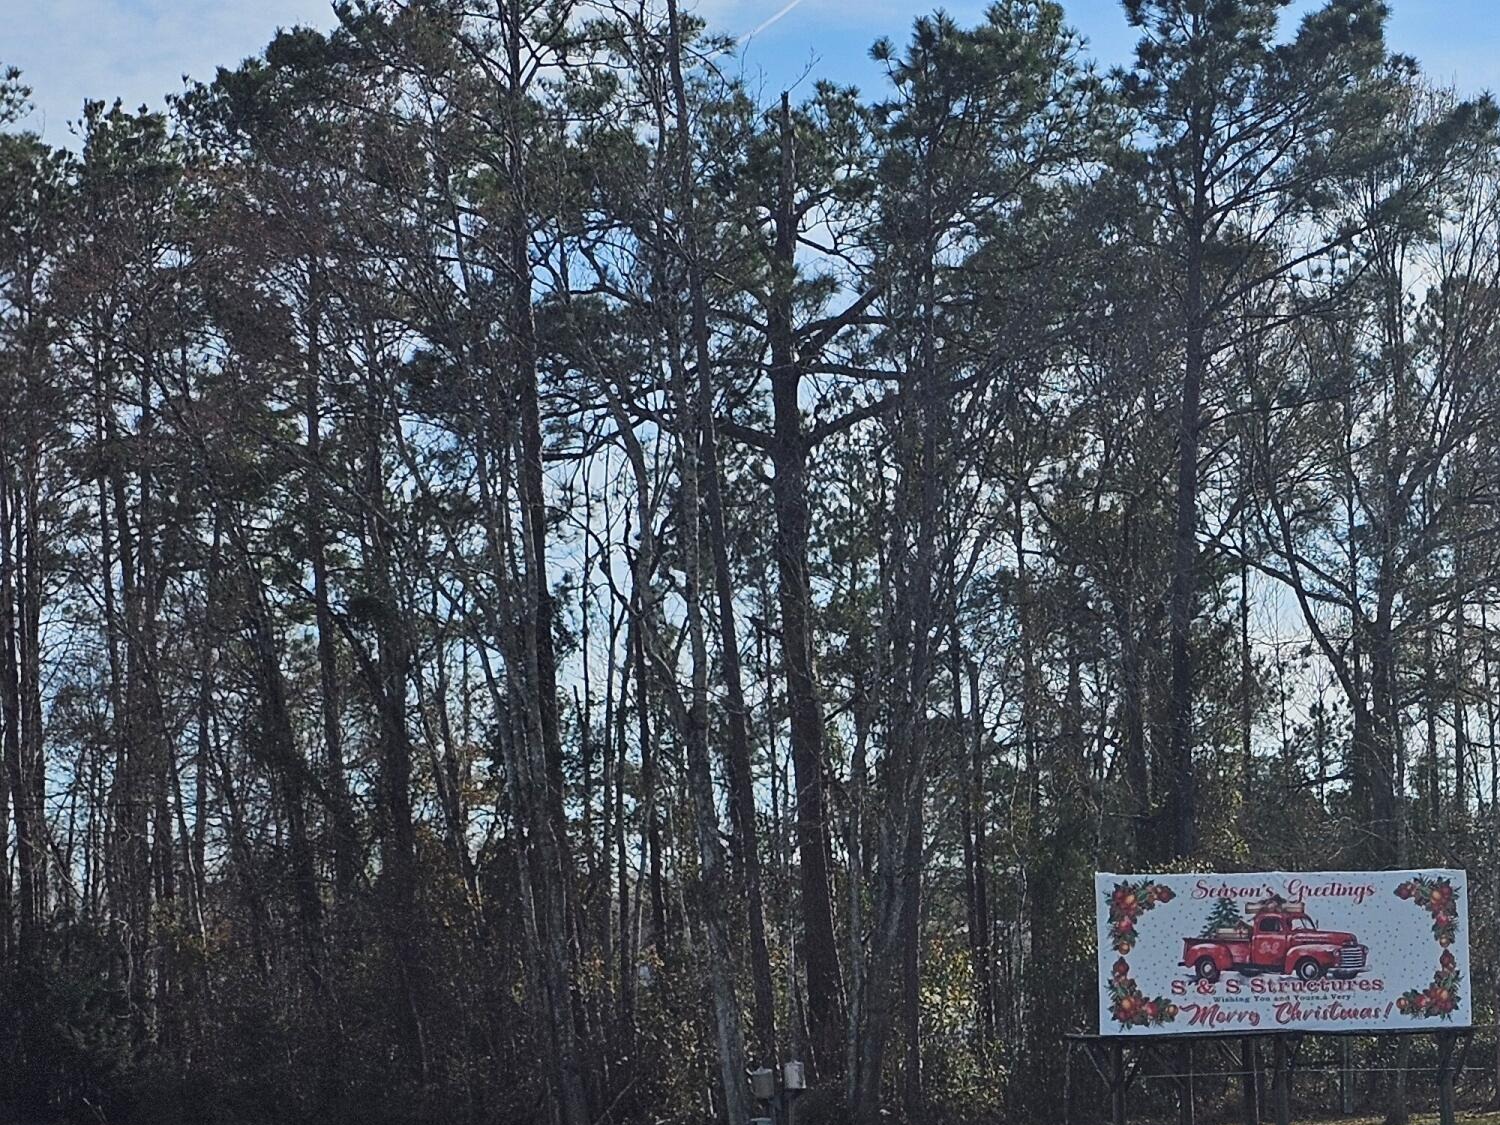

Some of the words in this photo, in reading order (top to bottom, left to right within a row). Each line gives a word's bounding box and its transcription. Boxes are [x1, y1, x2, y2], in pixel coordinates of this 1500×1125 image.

[1191, 879, 1275, 900] Season's
[1283, 878, 1376, 904] Greetings
[1170, 979, 1188, 995] S
[1195, 978, 1217, 995] &
[1225, 978, 1242, 994] S
[1250, 977, 1385, 995] Structures
[1179, 1003, 1261, 1029] Merry
[1272, 1001, 1394, 1026] Christmas!
